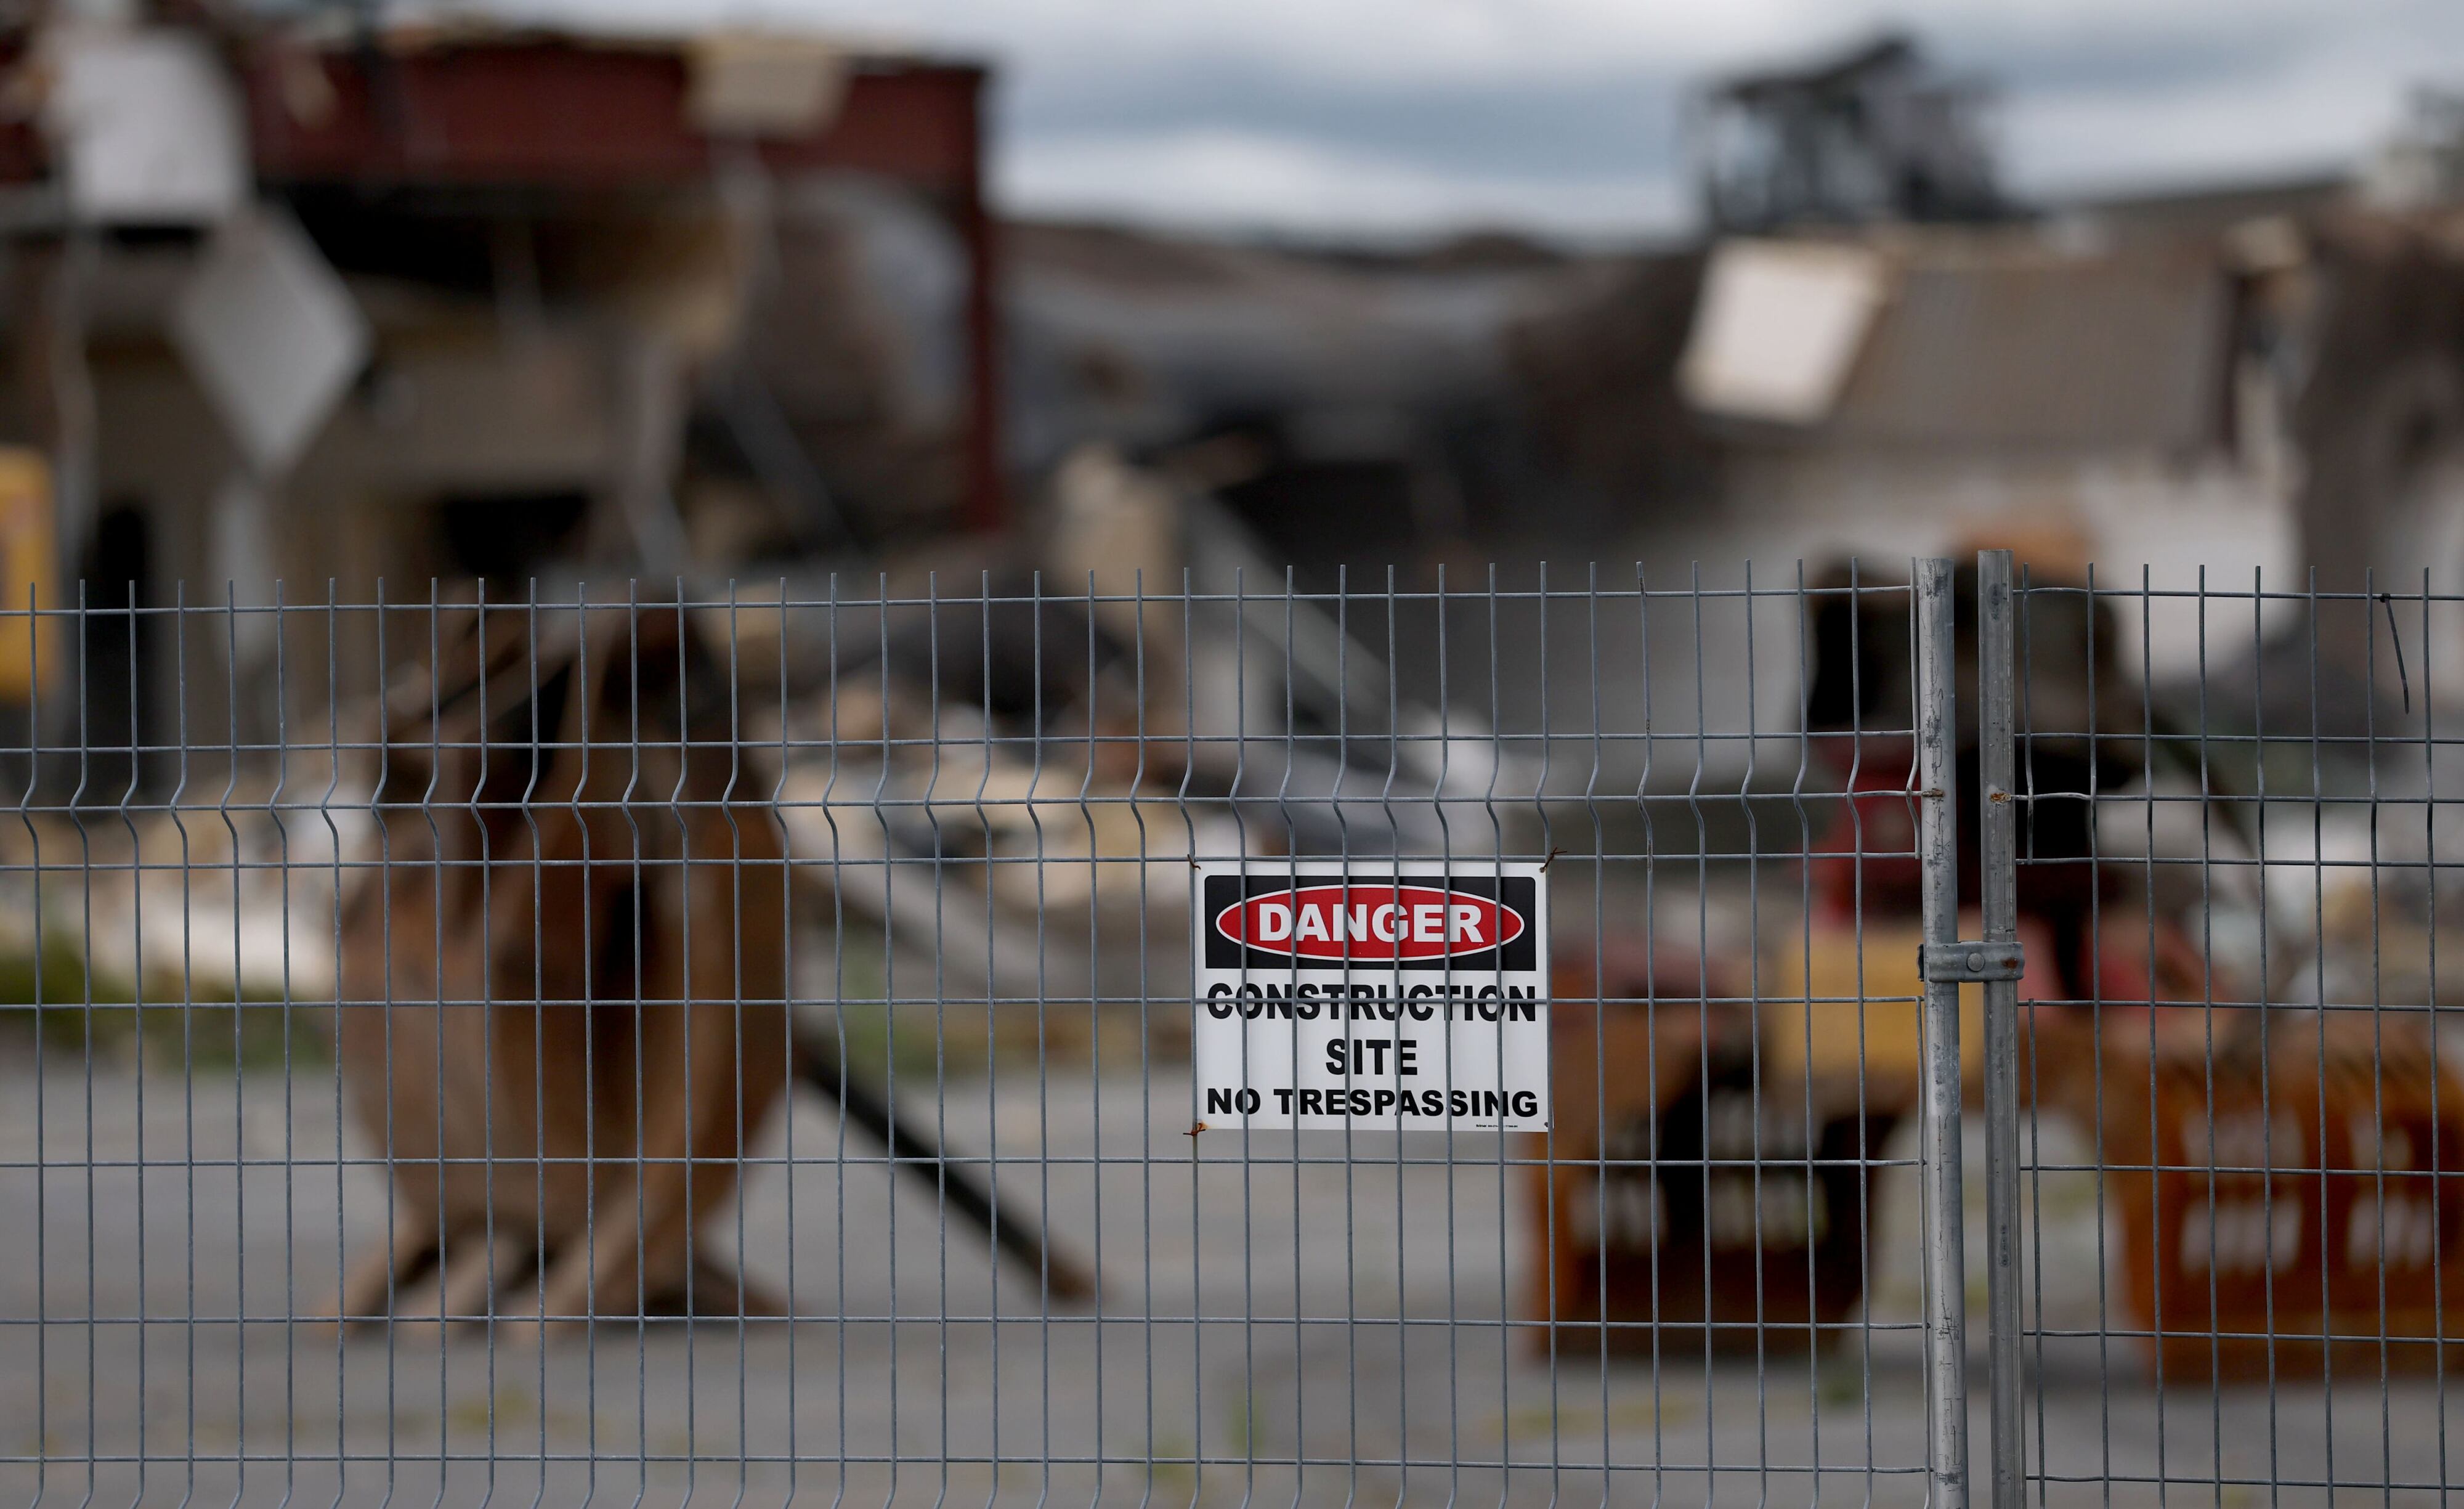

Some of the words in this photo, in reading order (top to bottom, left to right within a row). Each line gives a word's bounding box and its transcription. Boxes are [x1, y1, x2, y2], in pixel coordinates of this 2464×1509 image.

[1259, 903, 1484, 942] DANGER
[1207, 983, 1536, 1021] CONSTRUCTION
[1326, 1039, 1418, 1075] SITE
[1207, 1088, 1261, 1115] NO
[1274, 1089, 1538, 1117] TRESPASSING
